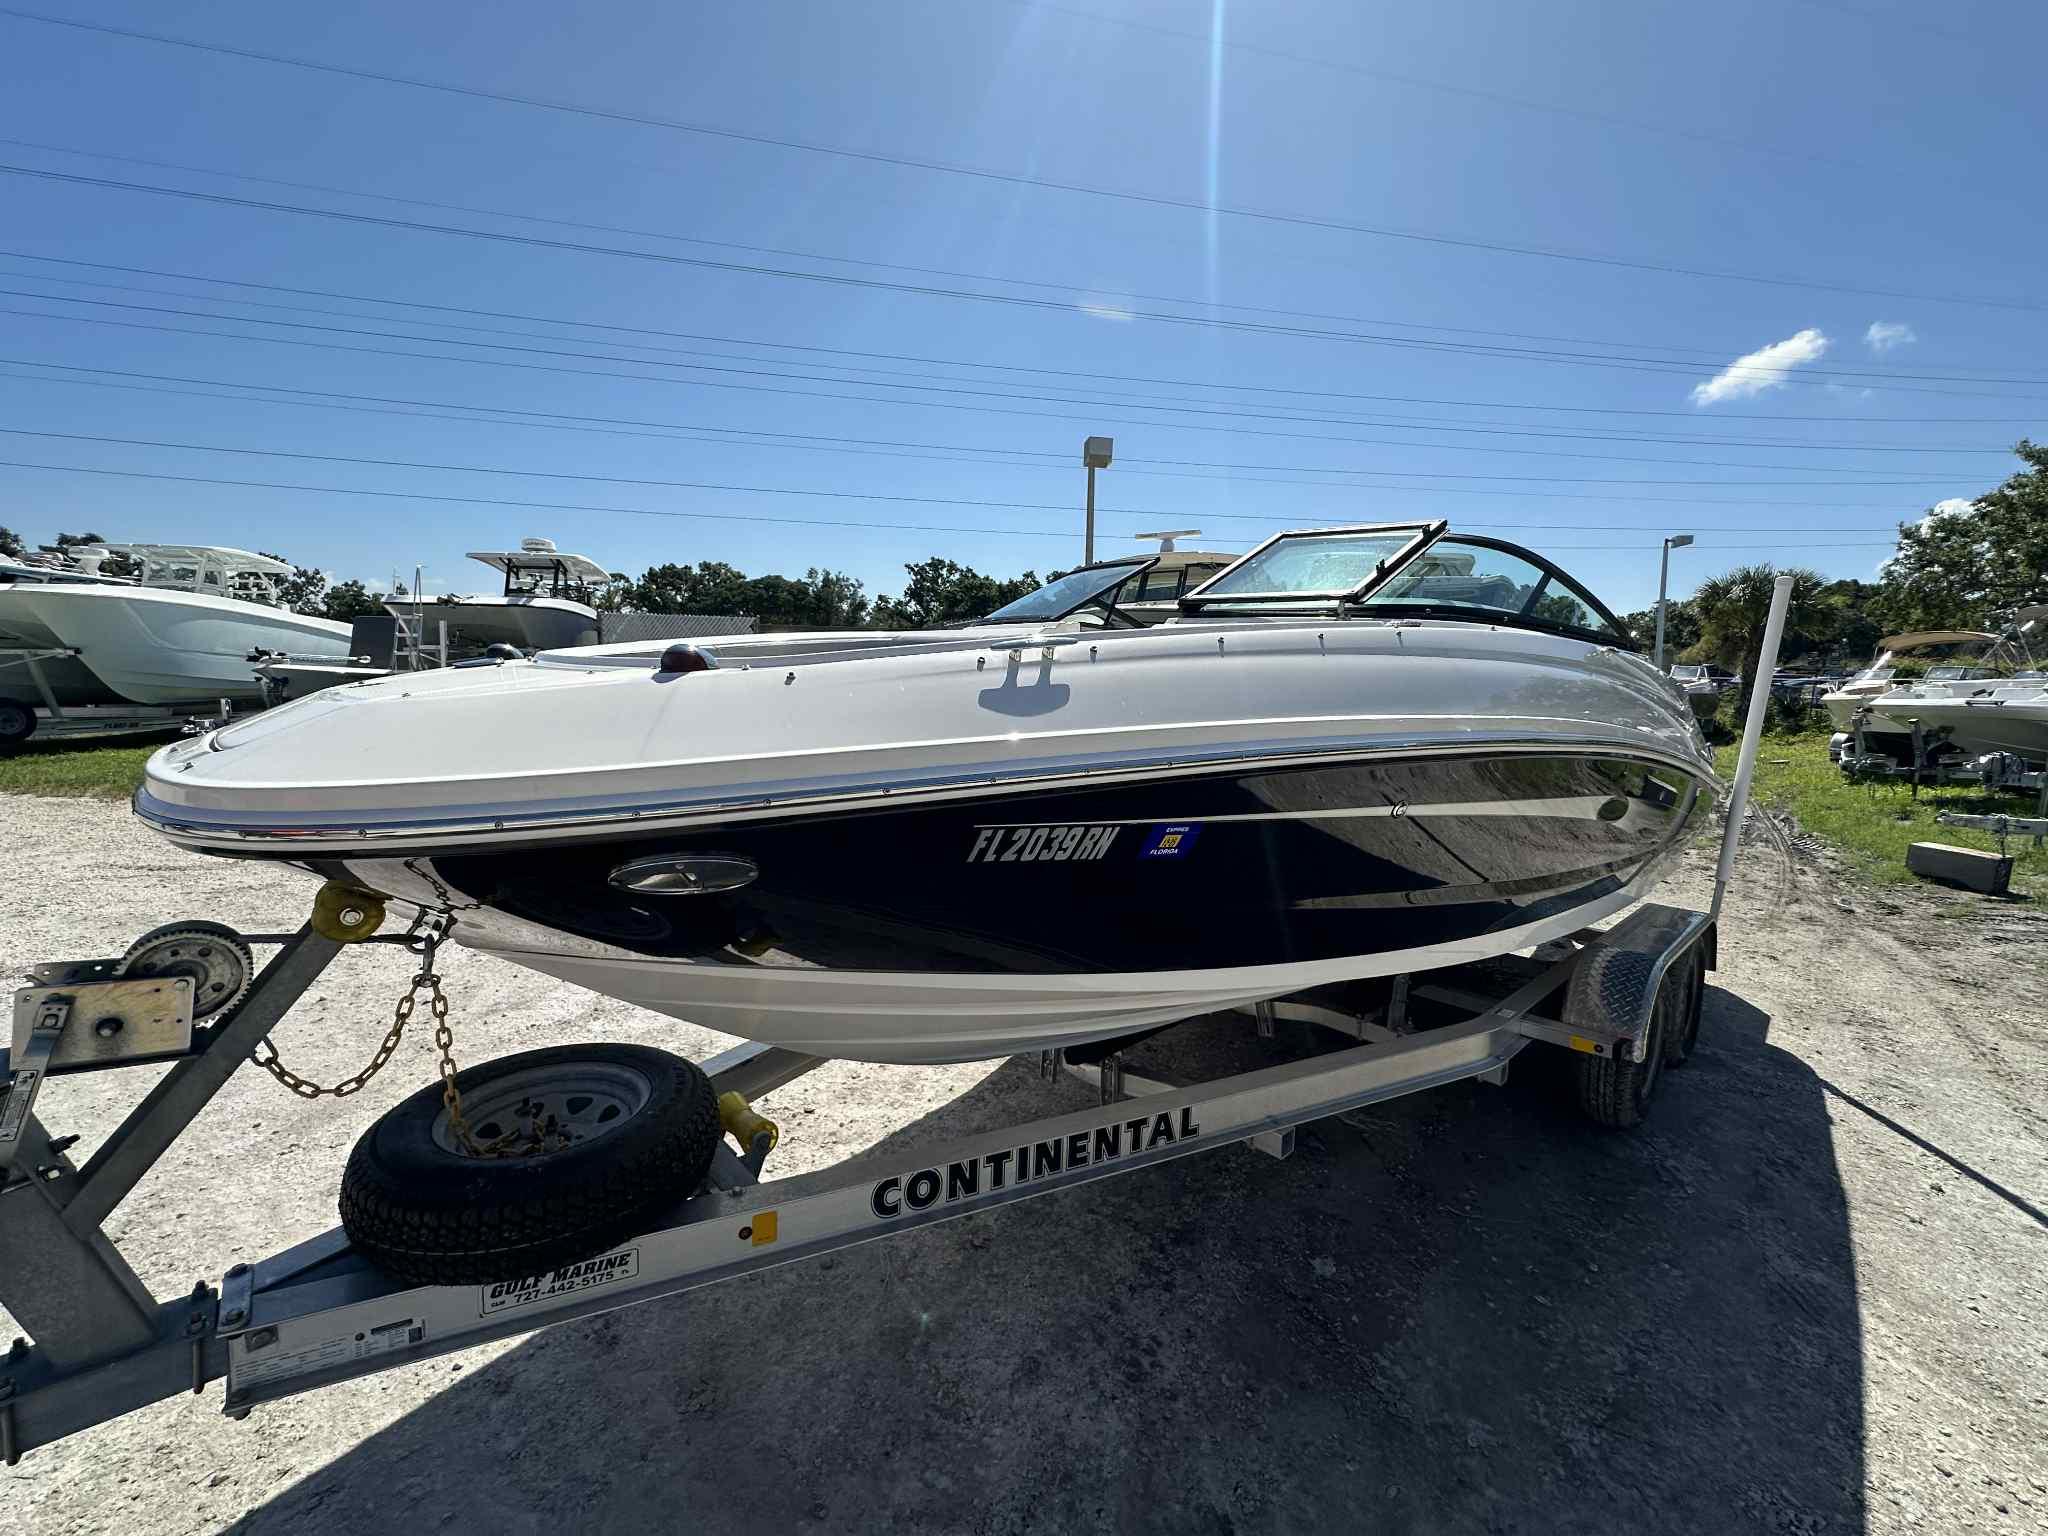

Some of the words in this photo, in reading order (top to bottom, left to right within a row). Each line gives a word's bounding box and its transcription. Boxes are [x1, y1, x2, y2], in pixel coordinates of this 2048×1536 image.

[870, 1104, 1201, 1219] CONTINENTAL
[490, 1272, 546, 1299] GULF
[550, 1252, 632, 1284] MARINE
[514, 1270, 615, 1304] 727-442-5175
